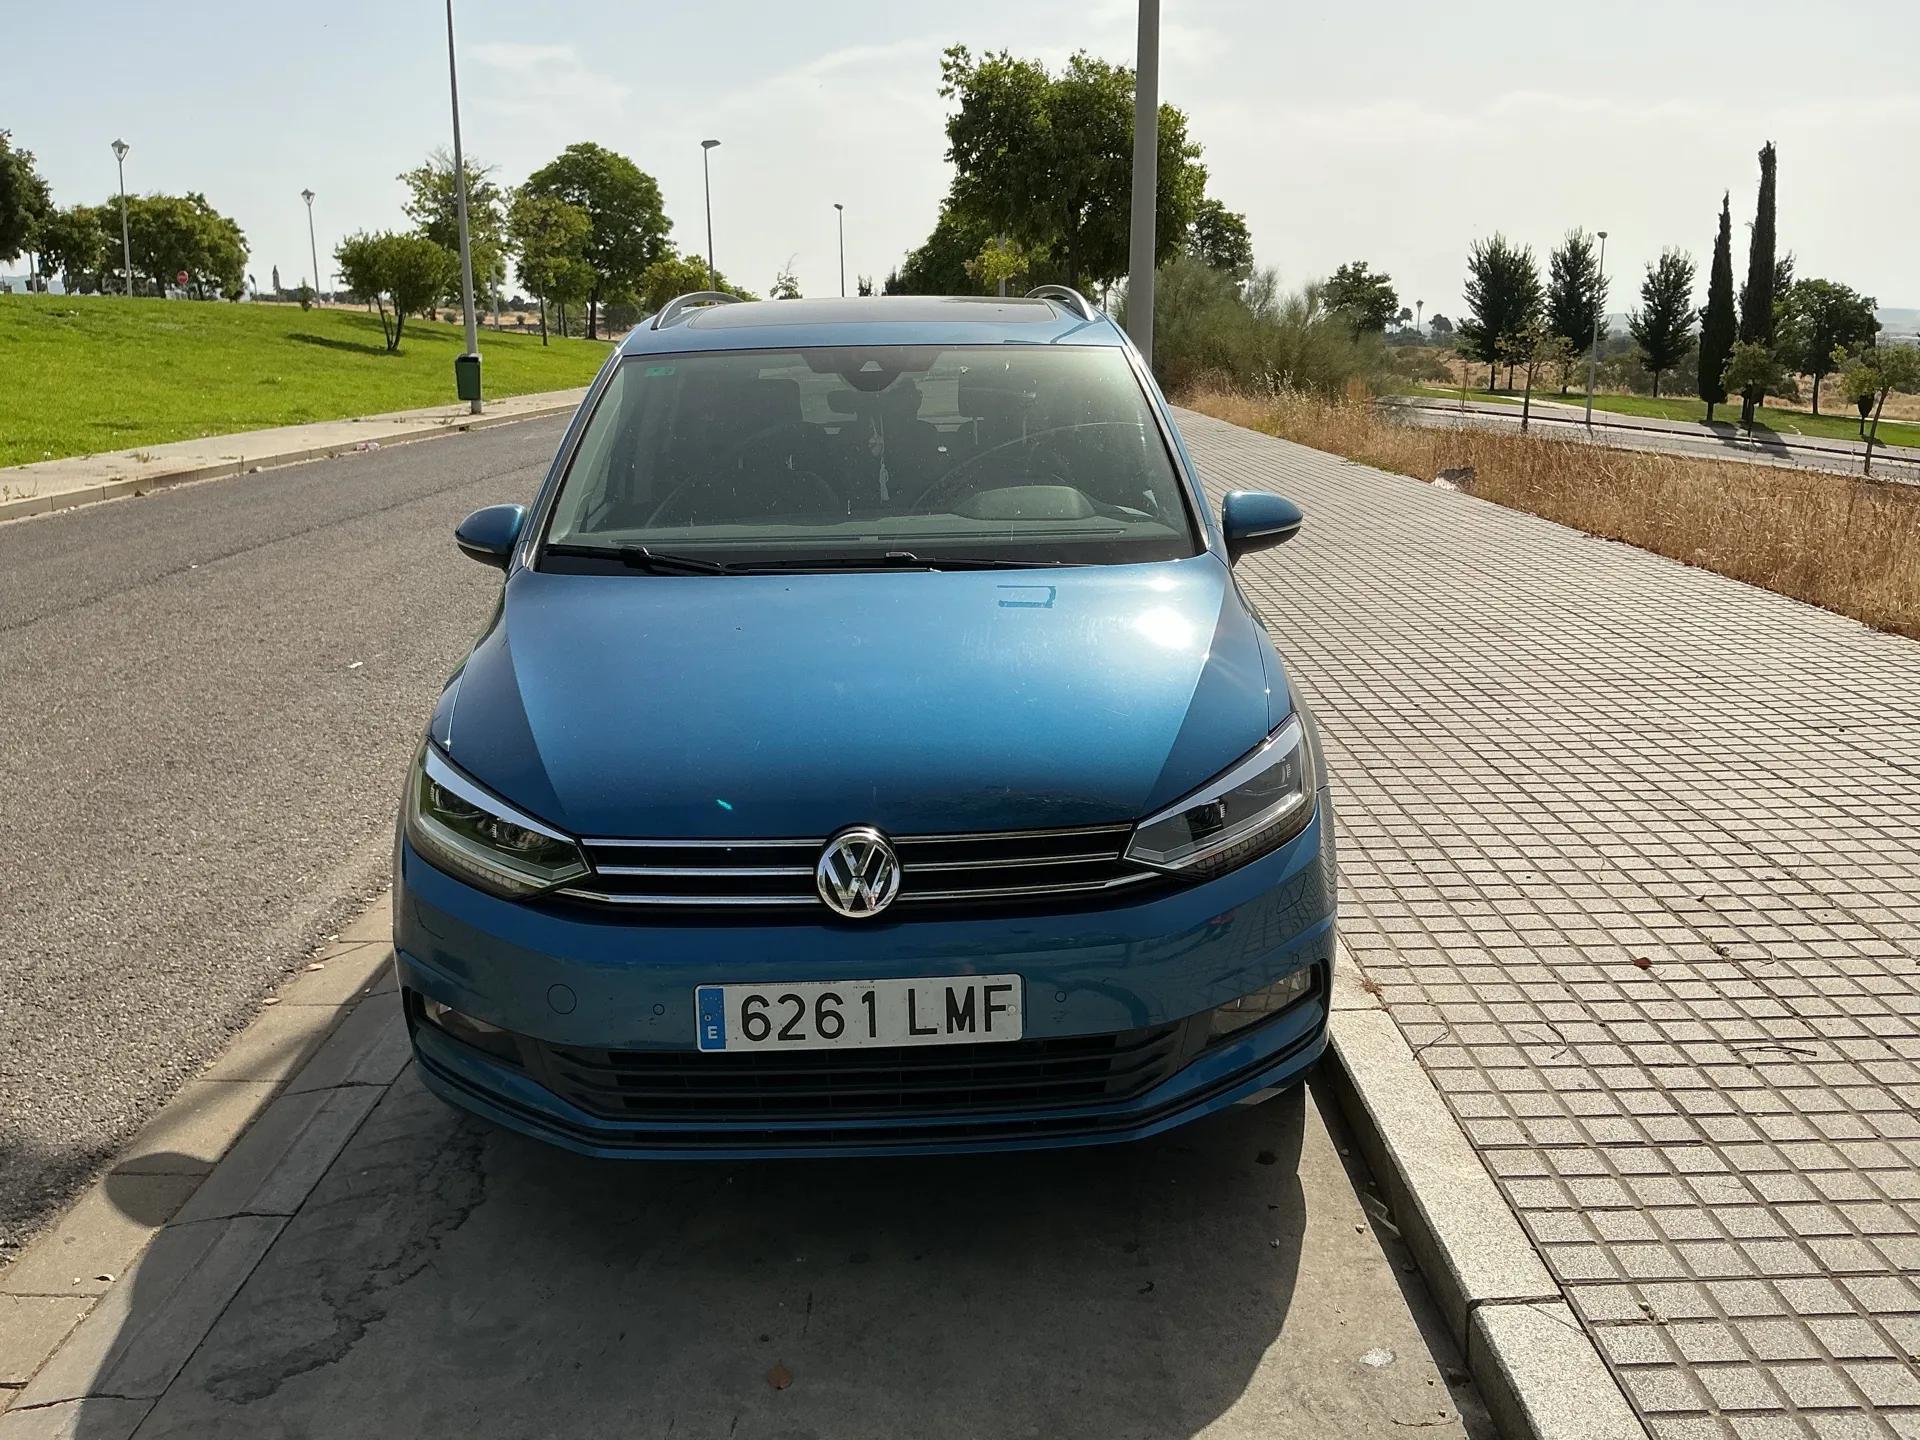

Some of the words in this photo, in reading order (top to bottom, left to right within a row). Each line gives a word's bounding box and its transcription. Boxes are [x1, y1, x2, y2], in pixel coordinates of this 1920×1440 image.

[820, 834, 898, 914] VW
[707, 1025, 718, 1040] E
[740, 990, 877, 1042] 6261
[907, 984, 1013, 1036] LMF
